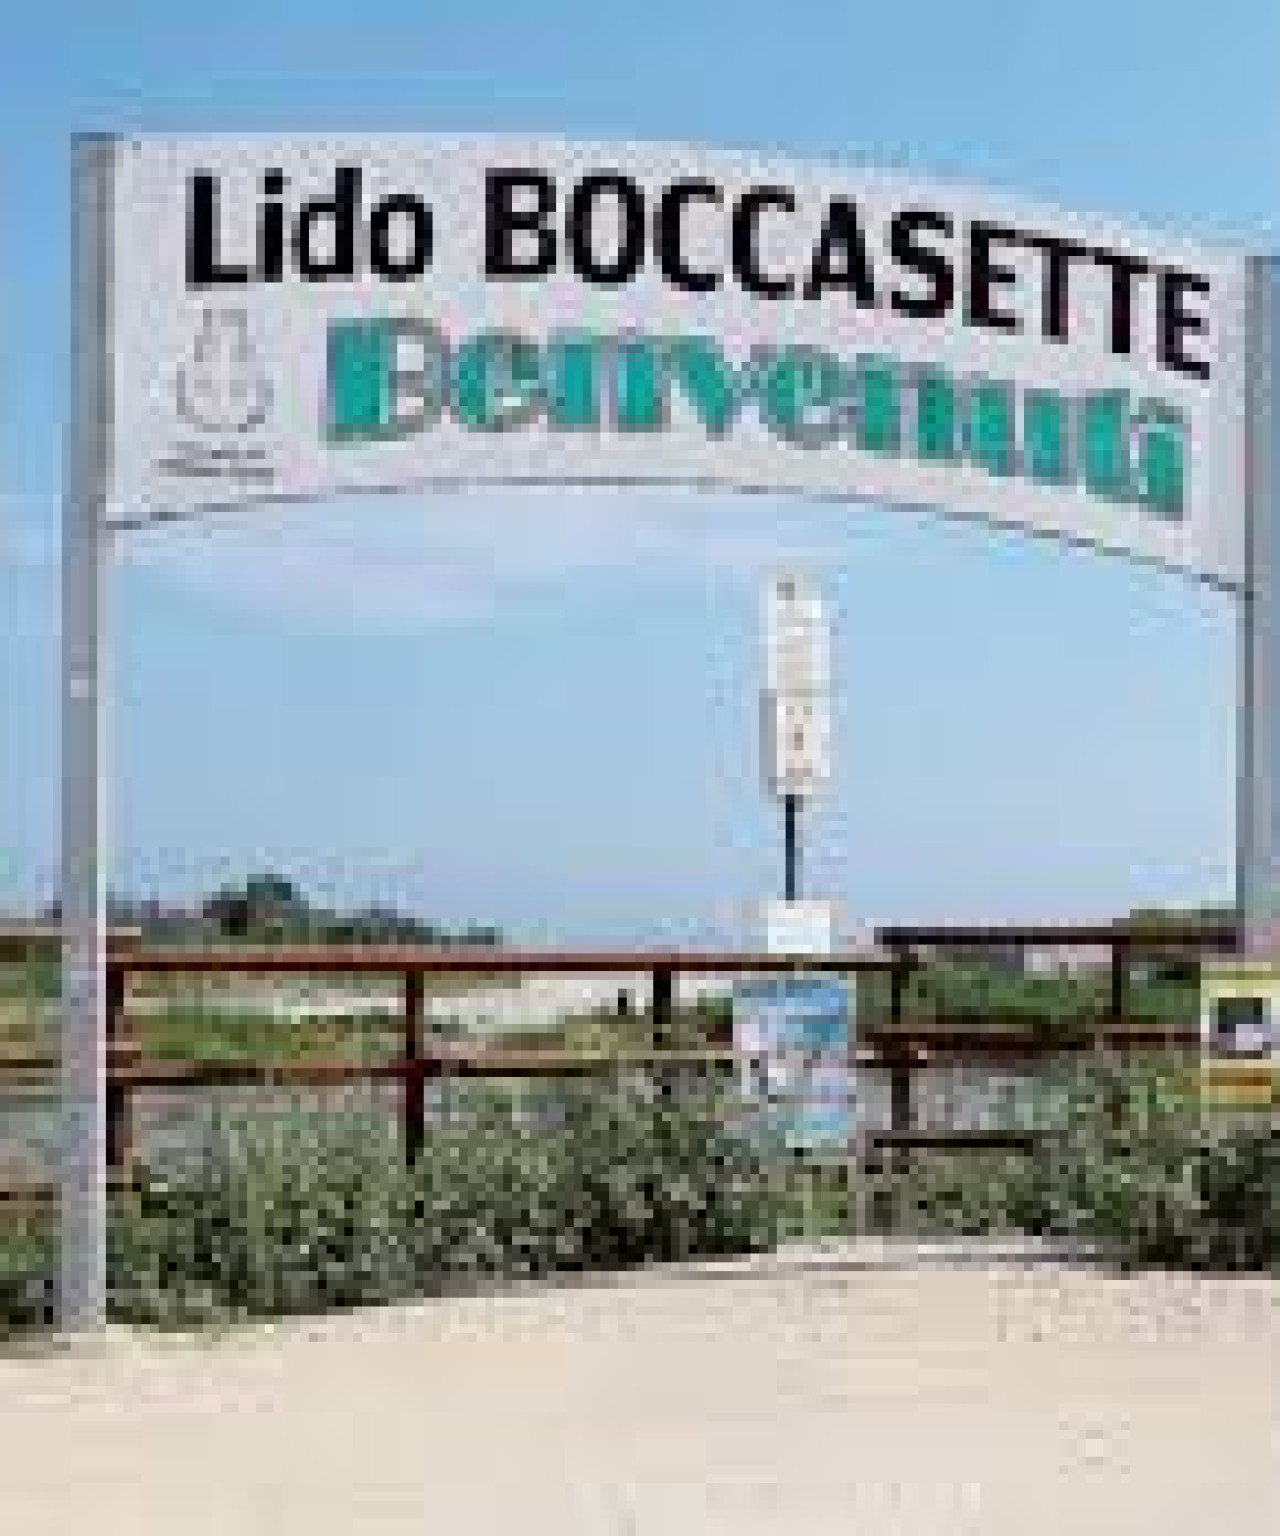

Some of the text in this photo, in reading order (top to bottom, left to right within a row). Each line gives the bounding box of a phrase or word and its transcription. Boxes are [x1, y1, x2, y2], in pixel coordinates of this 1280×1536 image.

[186, 167, 1211, 380] Lido BOCCASETTE
[321, 316, 1190, 518] Benvenuti
